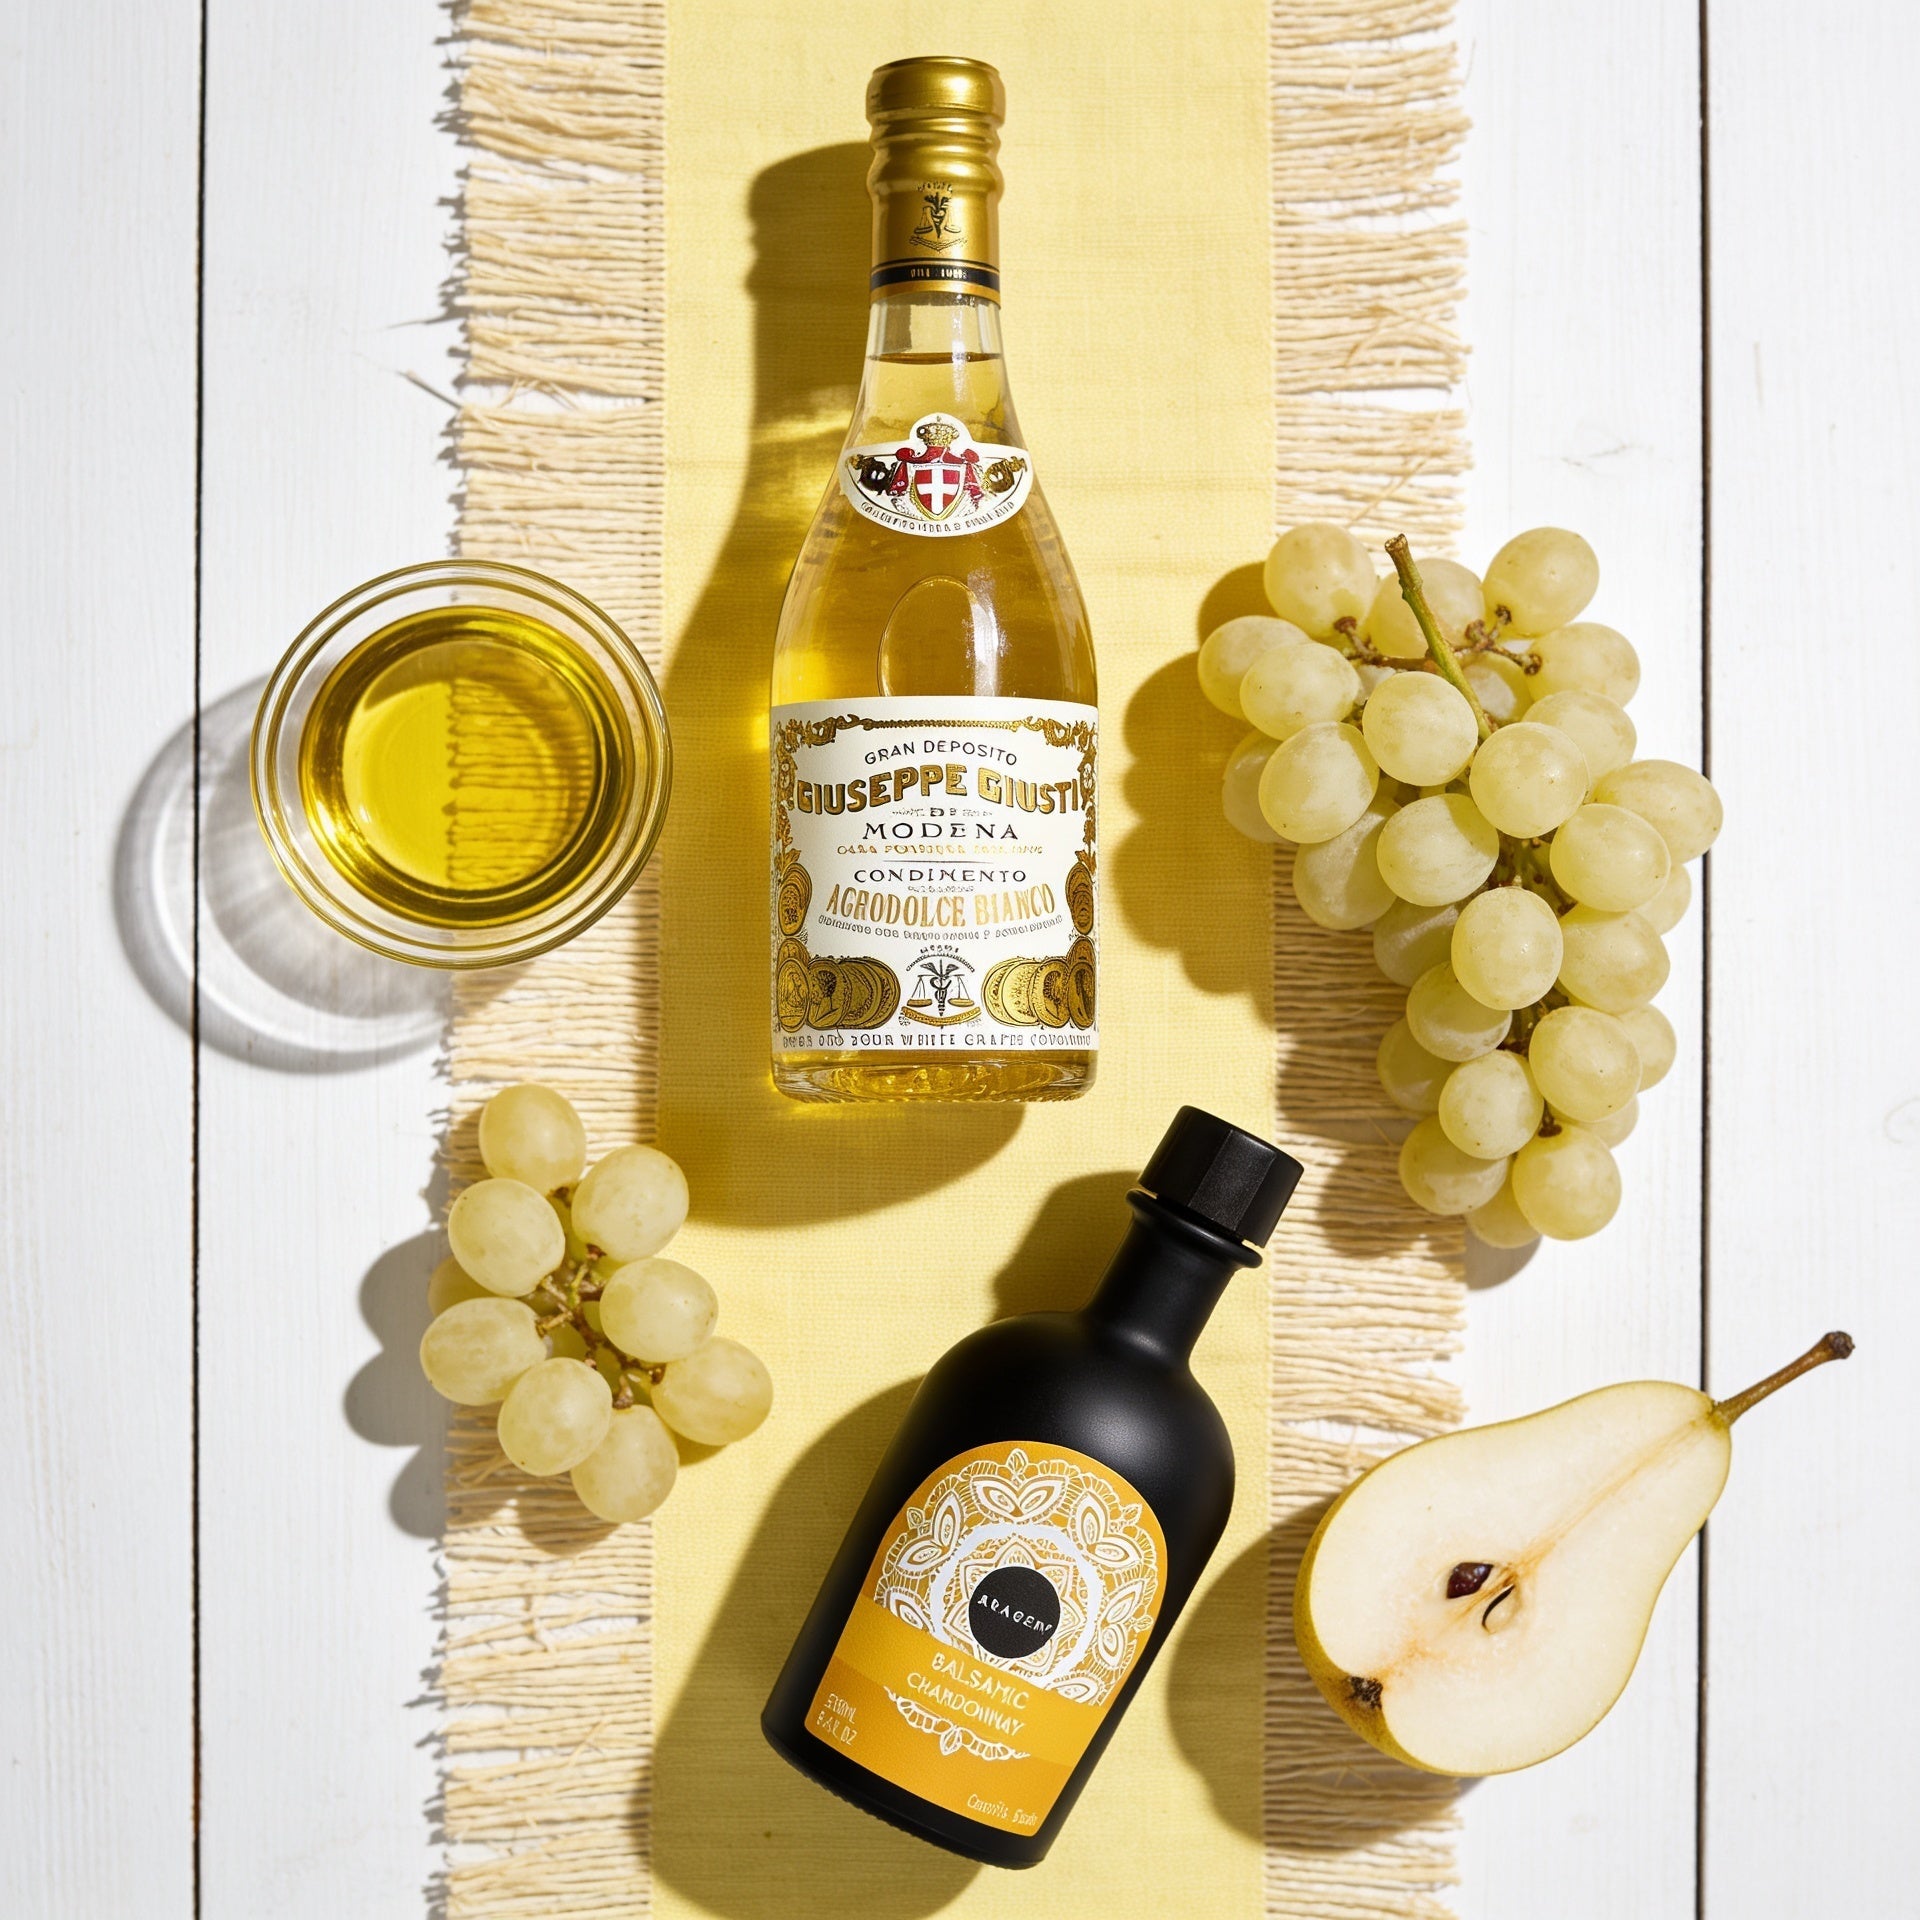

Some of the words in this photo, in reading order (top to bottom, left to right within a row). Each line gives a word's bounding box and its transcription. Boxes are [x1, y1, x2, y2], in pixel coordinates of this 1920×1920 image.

[864, 741, 915, 765] GRAN
[923, 740, 1018, 766] DEPOSITO
[797, 763, 968, 815] GIUSEPPE
[977, 766, 1079, 814] GIUSTI
[862, 822, 1019, 840] MODENA
[826, 883, 966, 927] AGRODOLCE
[974, 883, 1056, 926] BIANCO
[931, 1652, 1030, 1710] BALSAMIC
